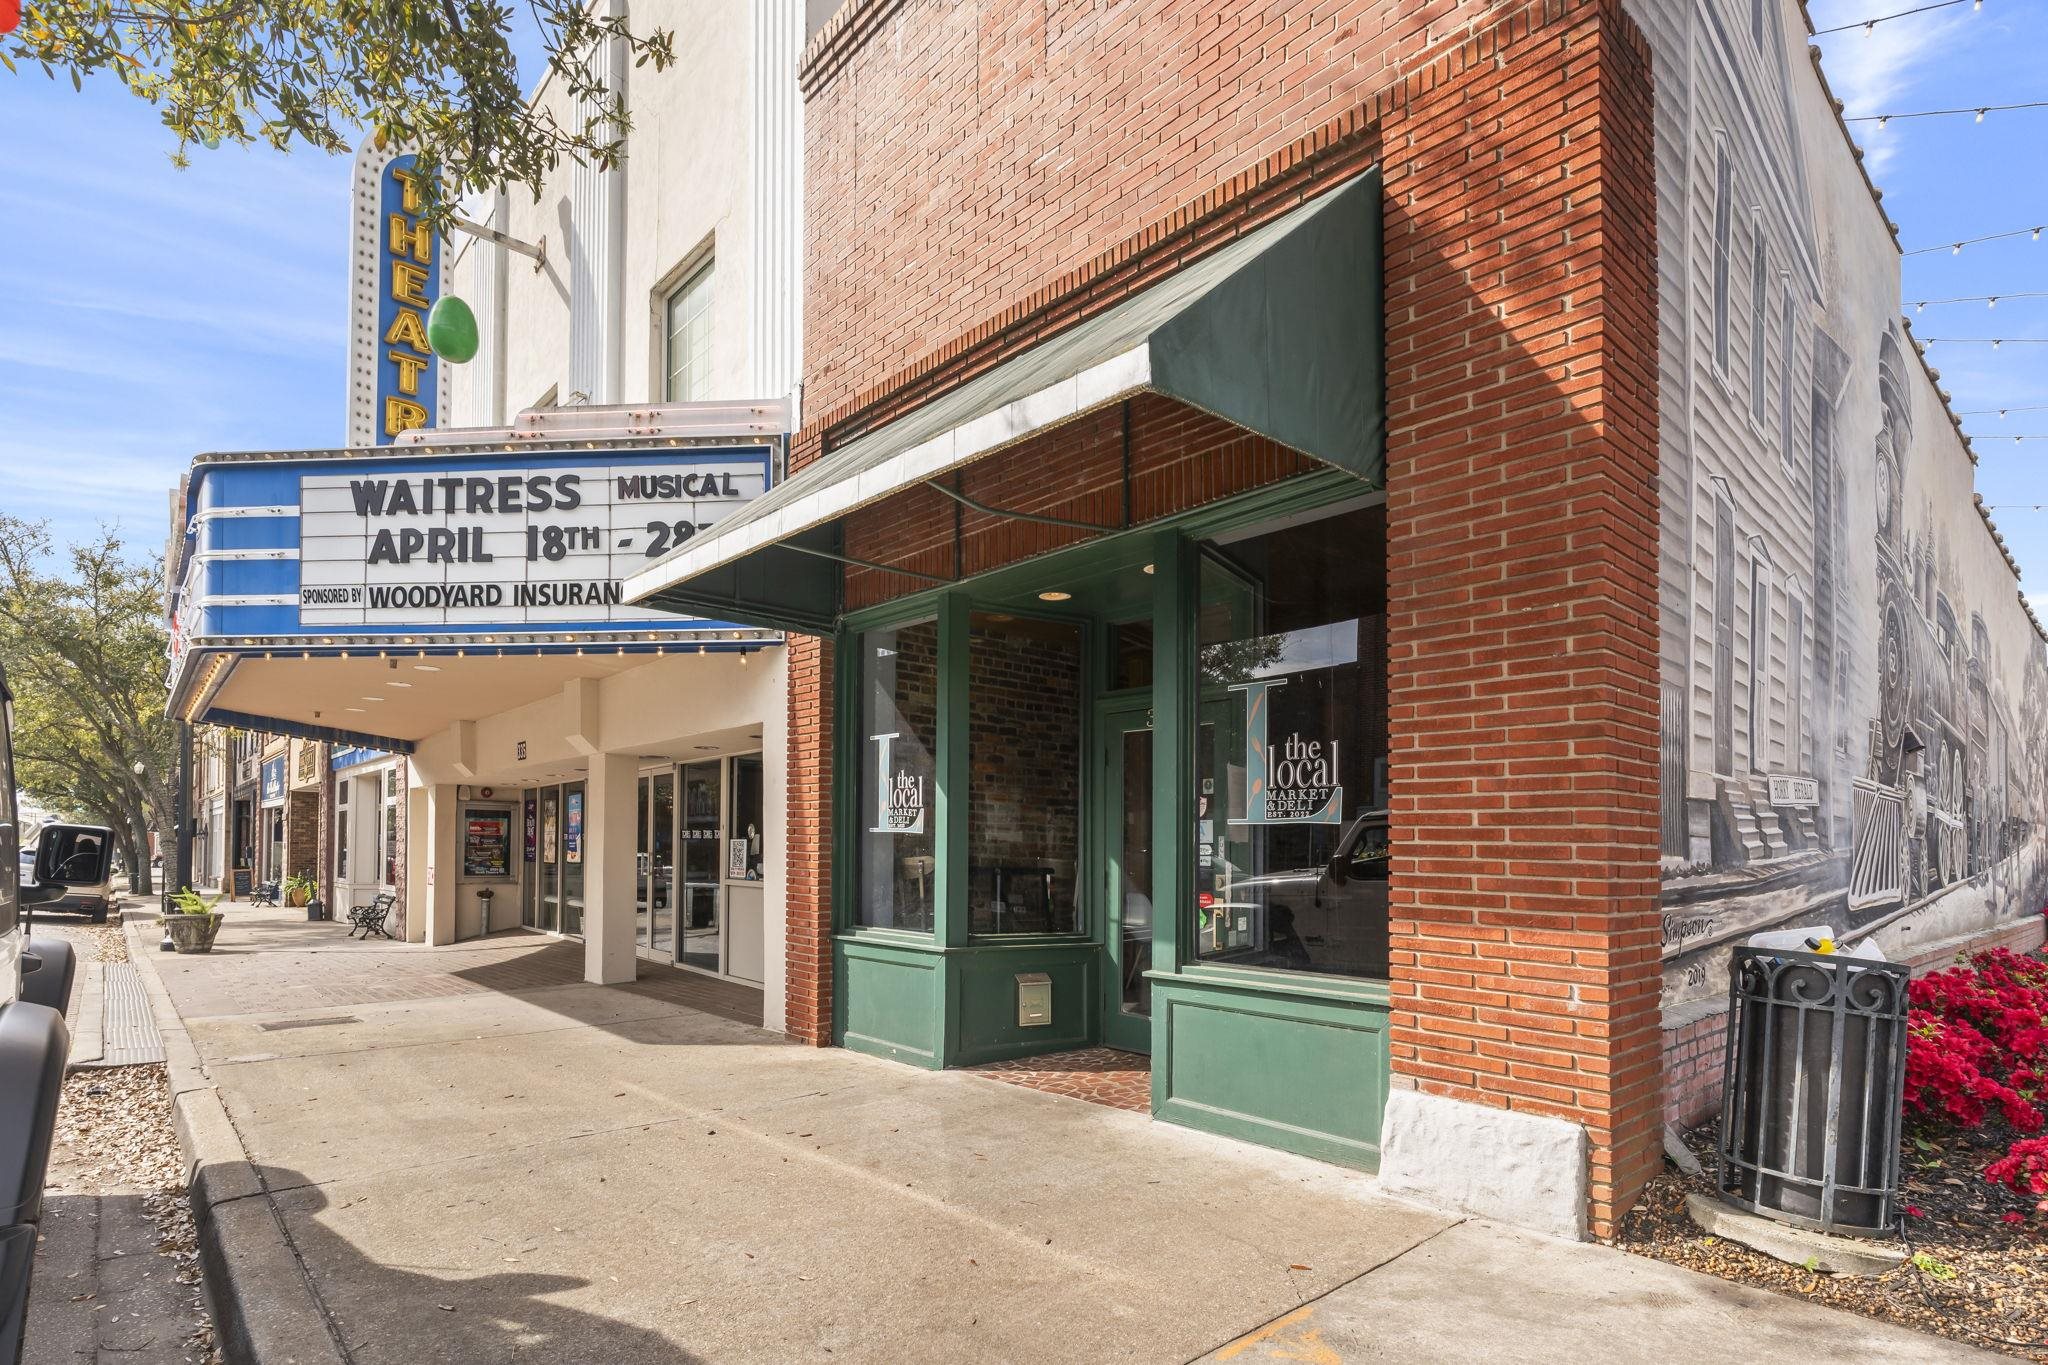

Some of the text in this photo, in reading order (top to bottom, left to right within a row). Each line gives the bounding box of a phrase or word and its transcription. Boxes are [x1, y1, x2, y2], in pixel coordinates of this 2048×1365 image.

[350, 472, 739, 516] WAITRESS MUSICAL
[367, 526, 493, 564] APRIL
[527, 525, 600, 562] 18TH
[302, 582, 624, 609] SPONSORED BY WOODYARD INSURAN
[1285, 732, 1321, 760] the
[1267, 739, 1341, 789] local
[889, 775, 924, 808] local
[897, 769, 915, 789] the
[1266, 788, 1329, 801] MARKET
[888, 808, 918, 817] MARKET
[1661, 913, 1714, 957] Simpson
[1688, 966, 1706, 988] 2019
